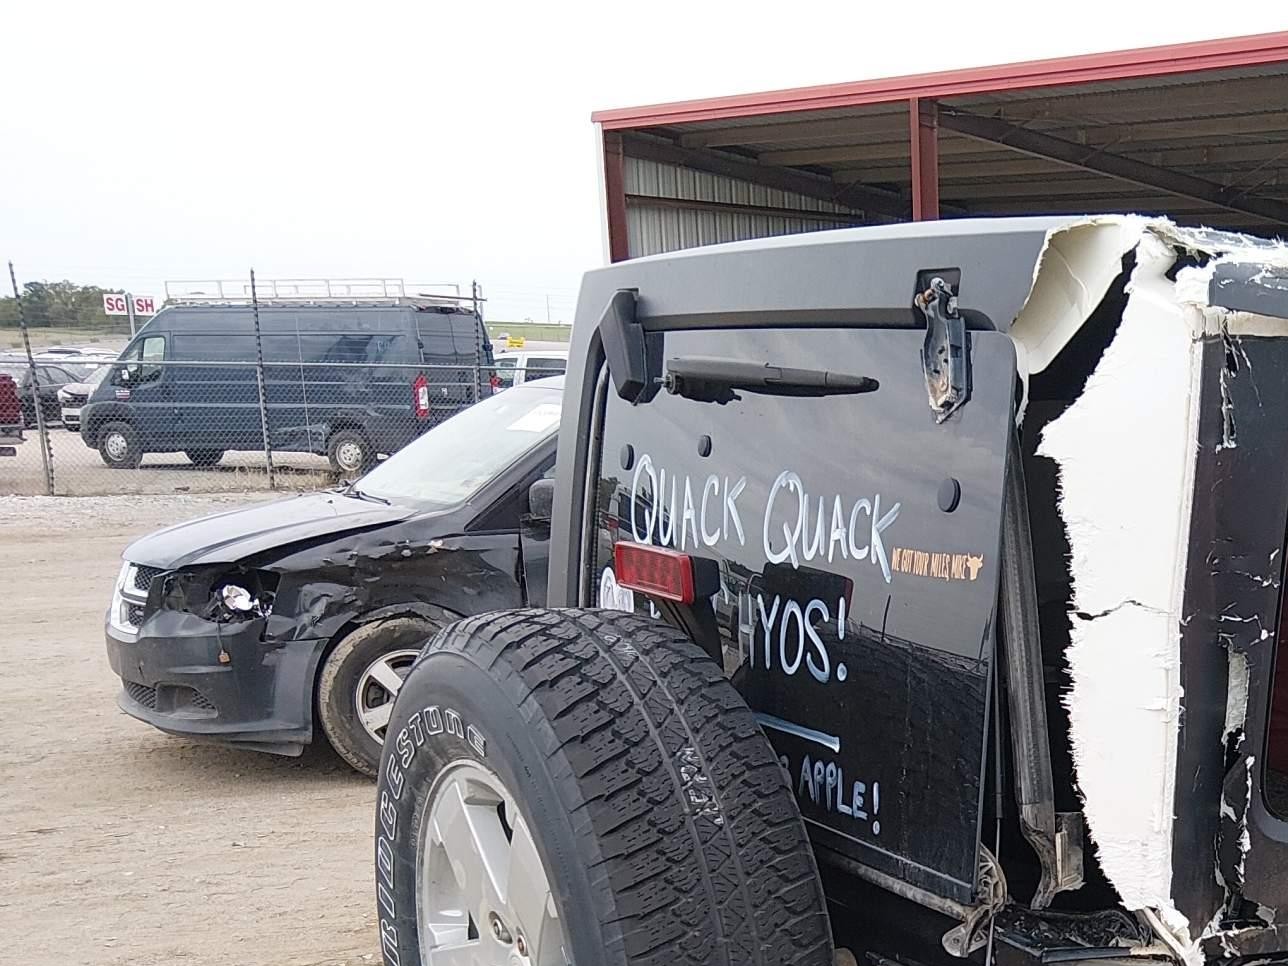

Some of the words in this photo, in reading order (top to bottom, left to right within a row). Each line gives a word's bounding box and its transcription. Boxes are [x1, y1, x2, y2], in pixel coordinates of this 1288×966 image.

[630, 454, 748, 549] QUACK
[763, 469, 901, 583] QUACK
[798, 754, 881, 836] APPLE!
